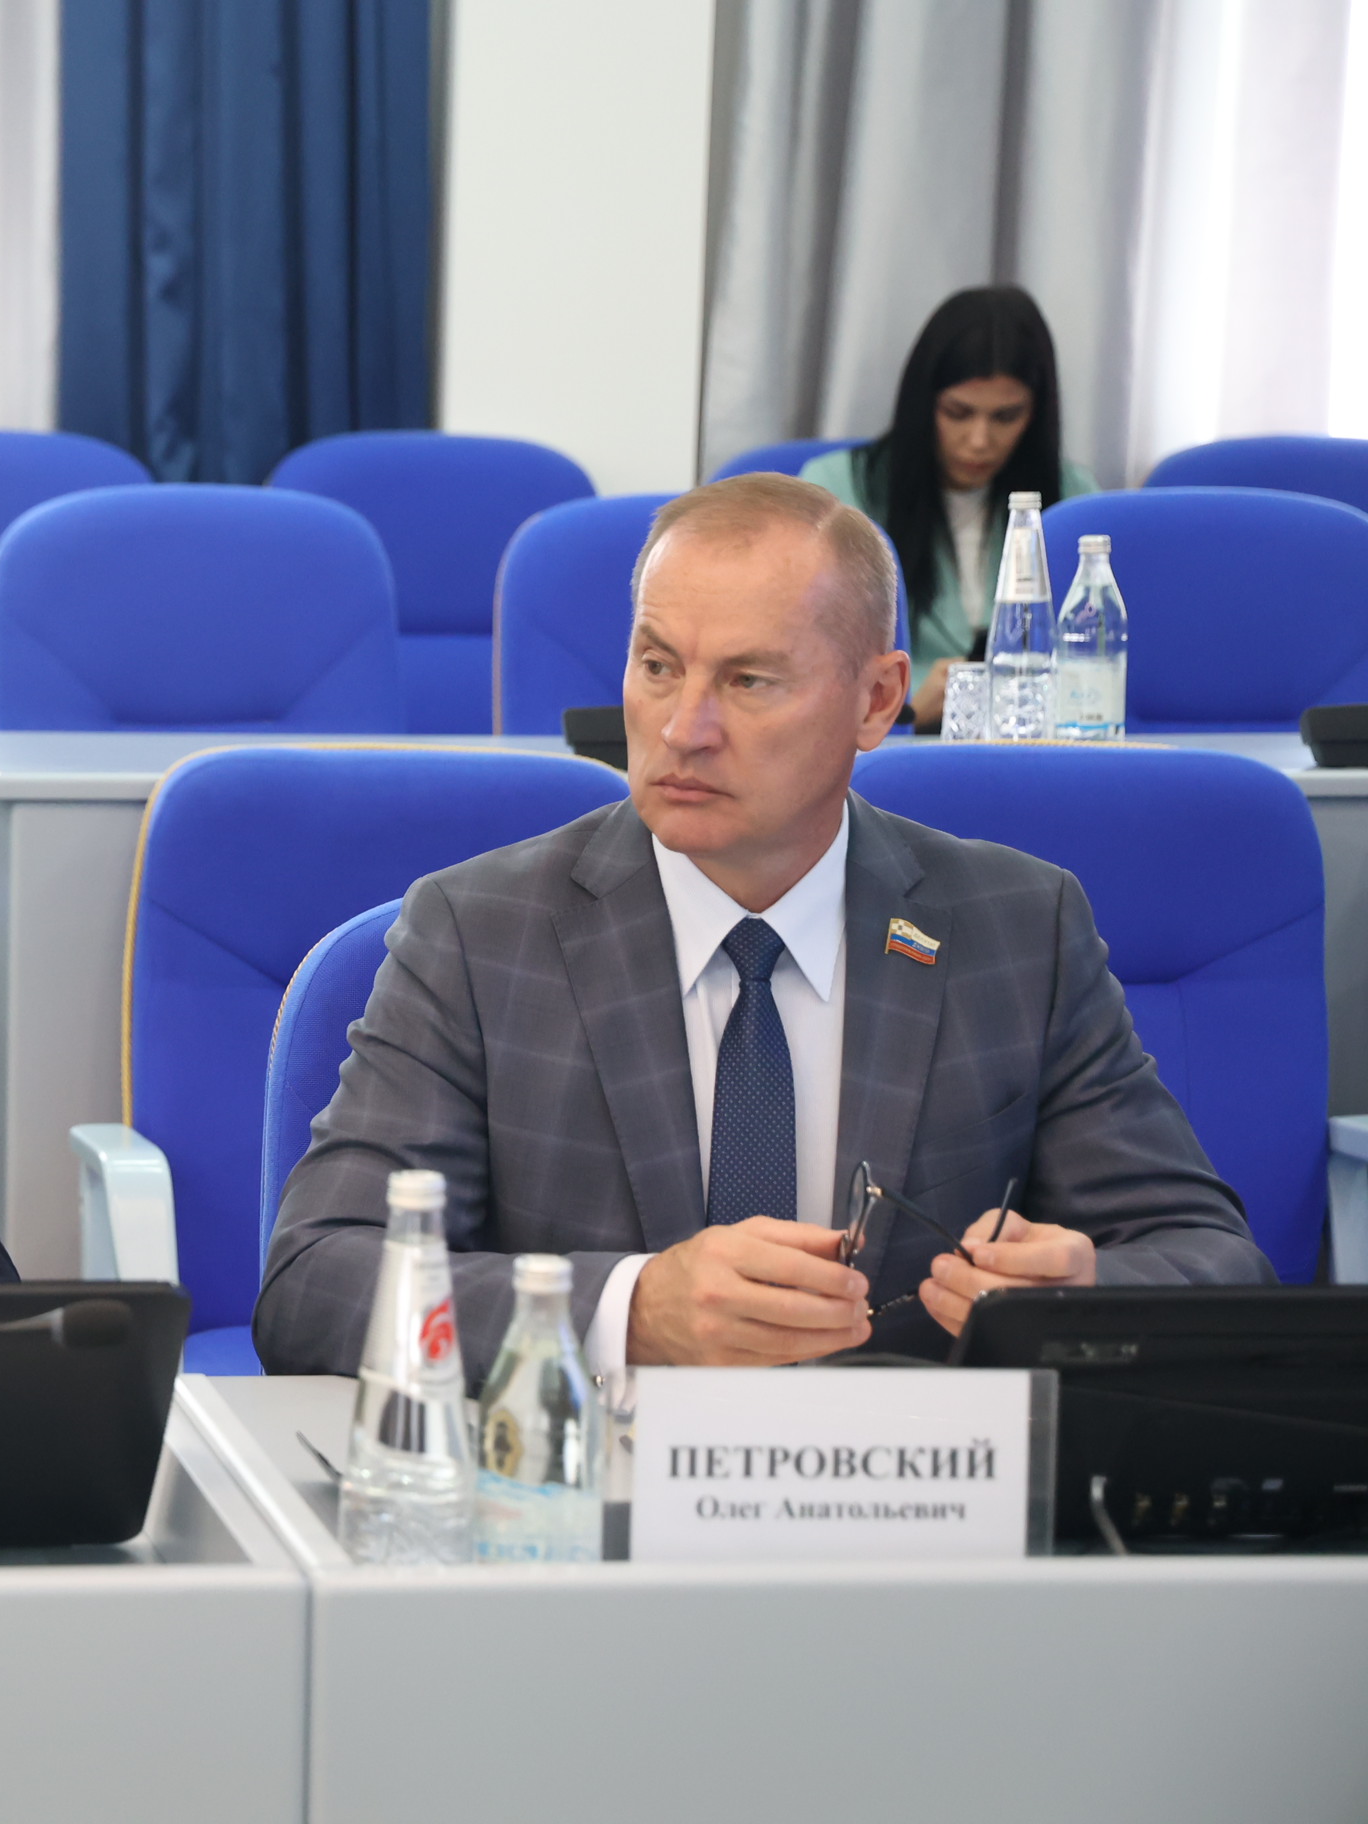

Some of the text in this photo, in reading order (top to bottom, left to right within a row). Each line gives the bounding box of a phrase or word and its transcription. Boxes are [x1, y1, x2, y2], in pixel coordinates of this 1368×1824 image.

[668, 1438, 998, 1481] ПЕТРОВСКИЙ
[695, 1496, 967, 1521] Олег Анатольевич
